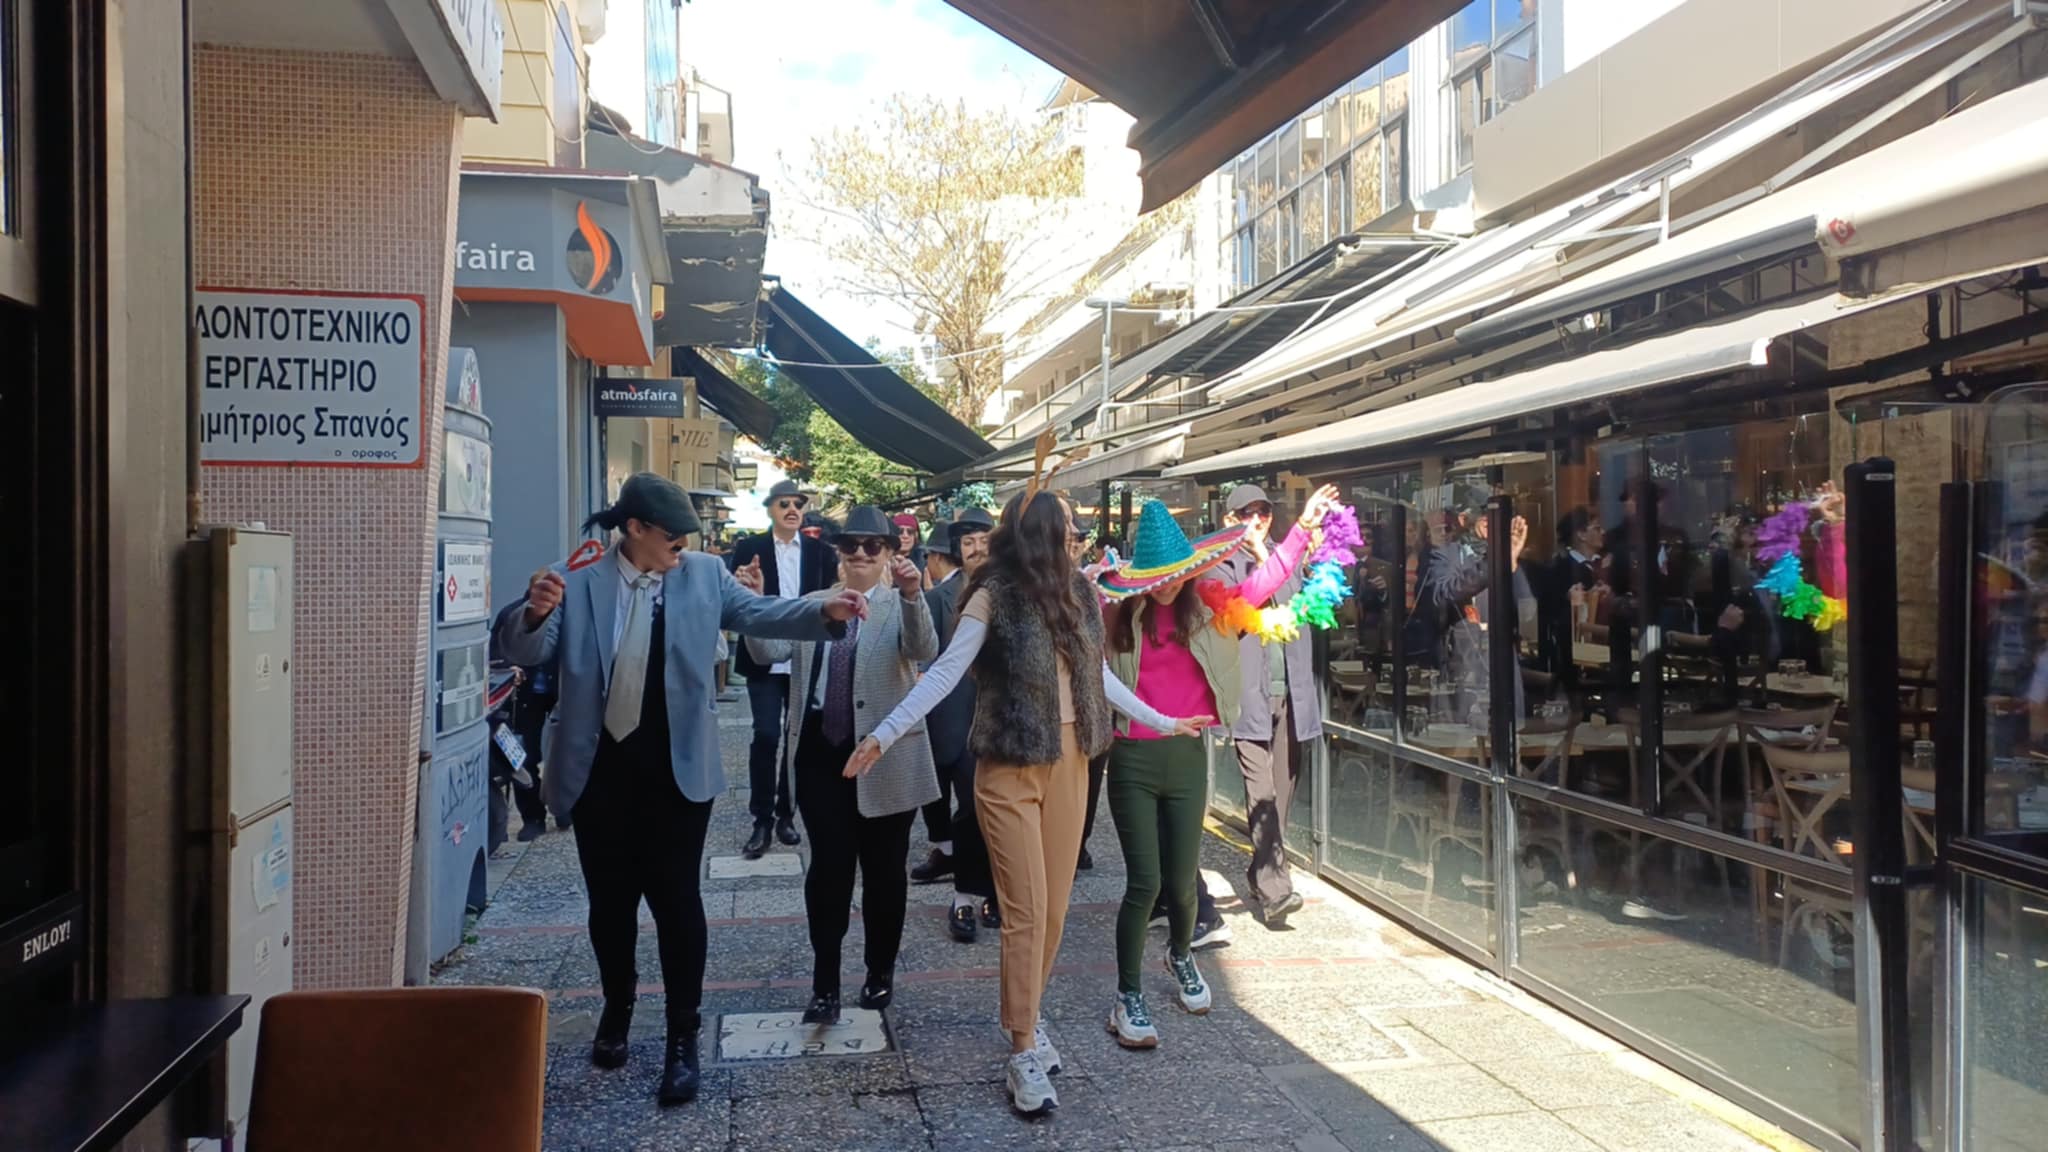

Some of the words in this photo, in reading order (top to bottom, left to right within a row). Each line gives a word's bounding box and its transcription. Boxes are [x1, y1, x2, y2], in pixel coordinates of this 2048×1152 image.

[455, 241, 536, 272] faira
[205, 355, 377, 393] ΕΡΓΑΣΤΗΡΙΟ
[600, 388, 677, 401] atmosfaira
[313, 406, 409, 447] Σπανός
[23, 919, 71, 962] ENLOY!
